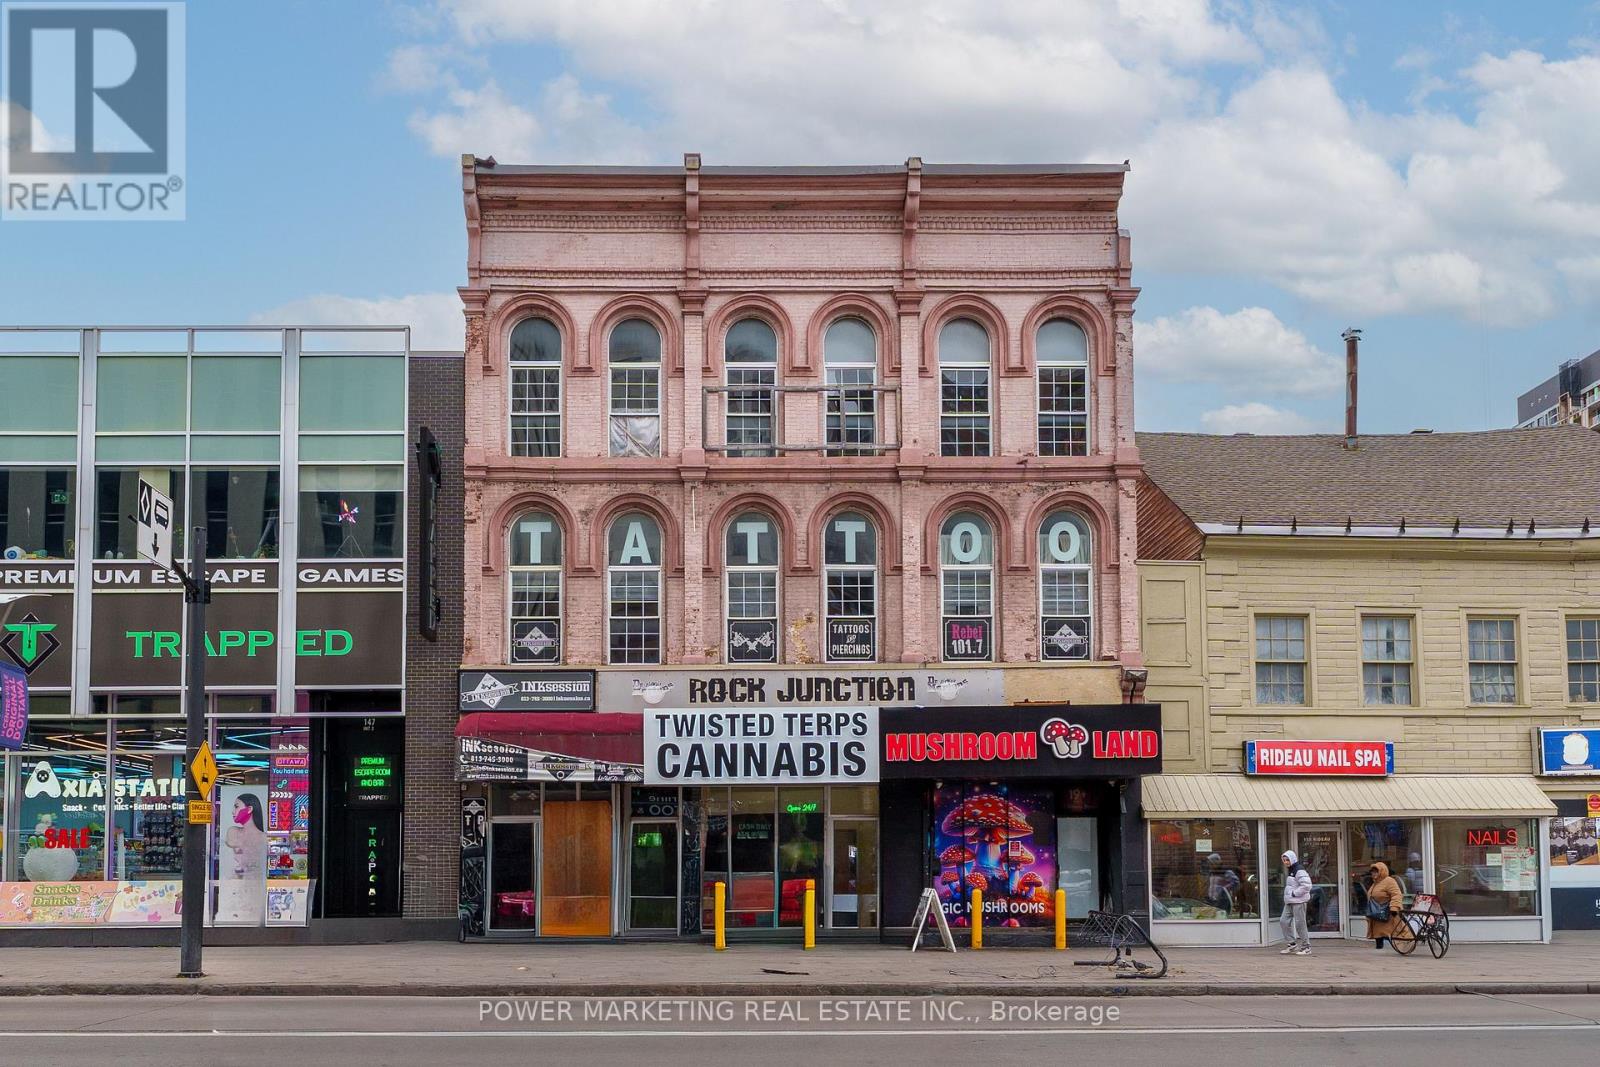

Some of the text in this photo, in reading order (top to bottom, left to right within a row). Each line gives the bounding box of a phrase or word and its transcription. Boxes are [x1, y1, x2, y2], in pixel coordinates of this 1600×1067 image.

[0, 569, 140, 584] REMIUM
[299, 568, 404, 583] GAMES
[832, 624, 870, 634] TATTOOS
[952, 624, 983, 639] Rebel
[832, 644, 871, 655] PIERCINGS
[952, 639, 983, 655] 101.7
[520, 680, 591, 692] INKsession
[689, 677, 766, 703] ROCK
[6, 676, 18, 738] ORIGINAL
[13, 679, 26, 740] D'OTTAWA
[364, 718, 376, 726] 147
[655, 712, 868, 738] TWISTED TERPS
[885, 730, 1158, 761] MUSHROOM LAND
[276, 758, 305, 766] OTTAWA
[657, 741, 867, 779] CANNABIS
[1260, 748, 1382, 767] RIDEAU NAIL SPA
[786, 804, 801, 813] Open
[44, 828, 92, 849] SALE
[1468, 829, 1518, 845] NAILS
[34, 884, 81, 895] Snacks
[32, 896, 77, 907] Drinks
